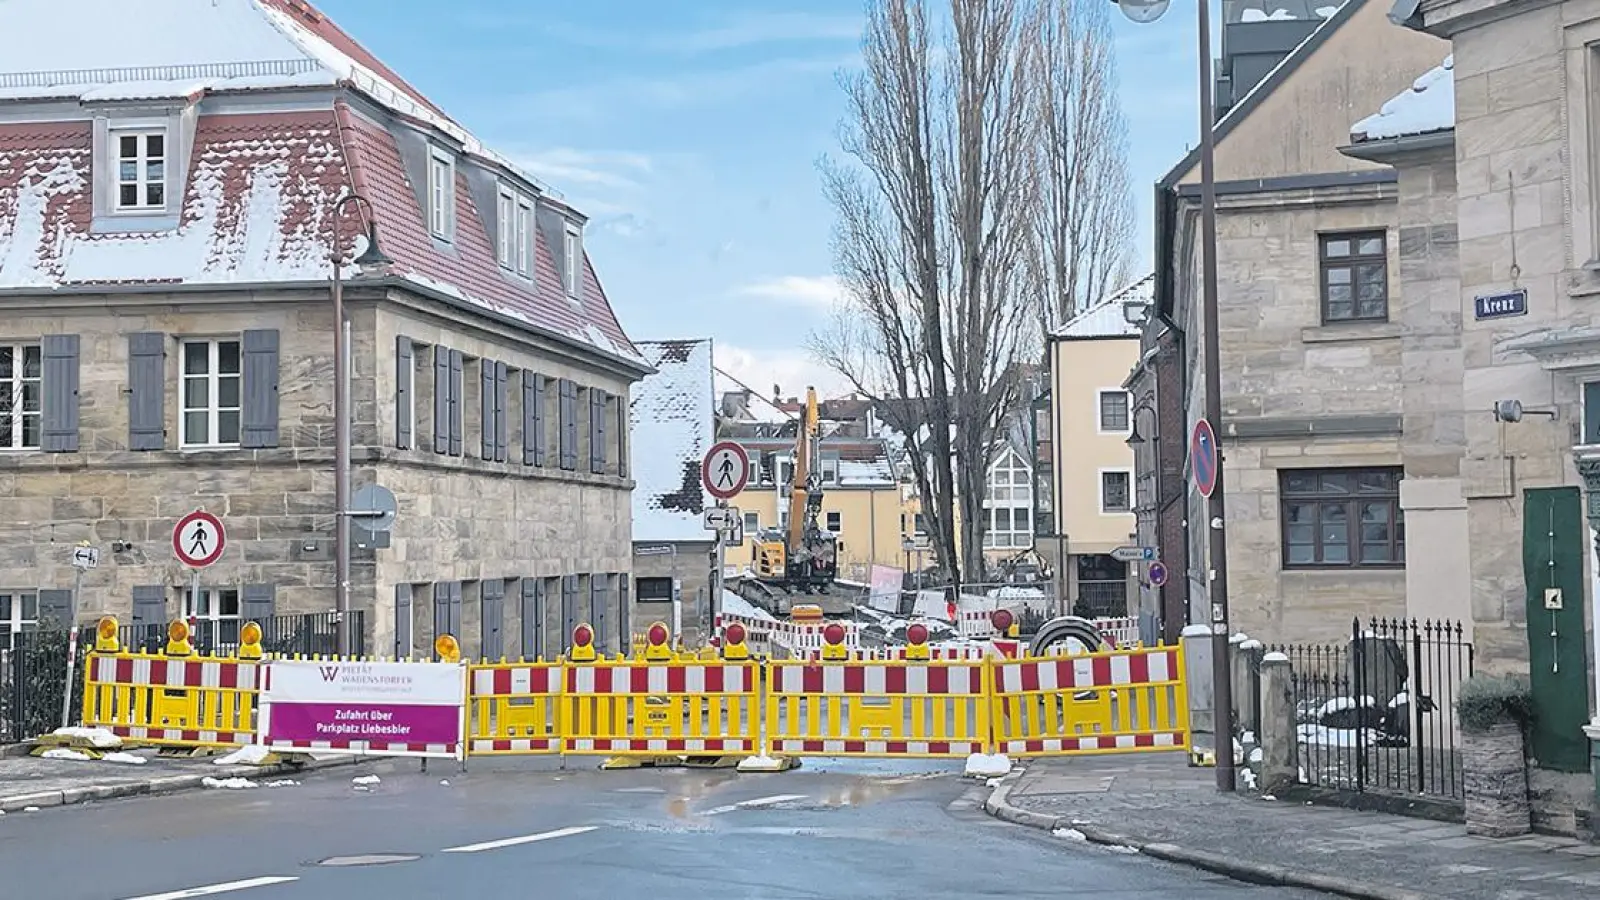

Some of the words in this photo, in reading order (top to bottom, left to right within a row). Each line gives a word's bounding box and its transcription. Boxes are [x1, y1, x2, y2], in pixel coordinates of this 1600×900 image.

[335, 709, 368, 720] Zufahrt
[370, 710, 393, 720] über
[316, 722, 359, 735] Parkplatz
[361, 723, 410, 734] Liebesbier
